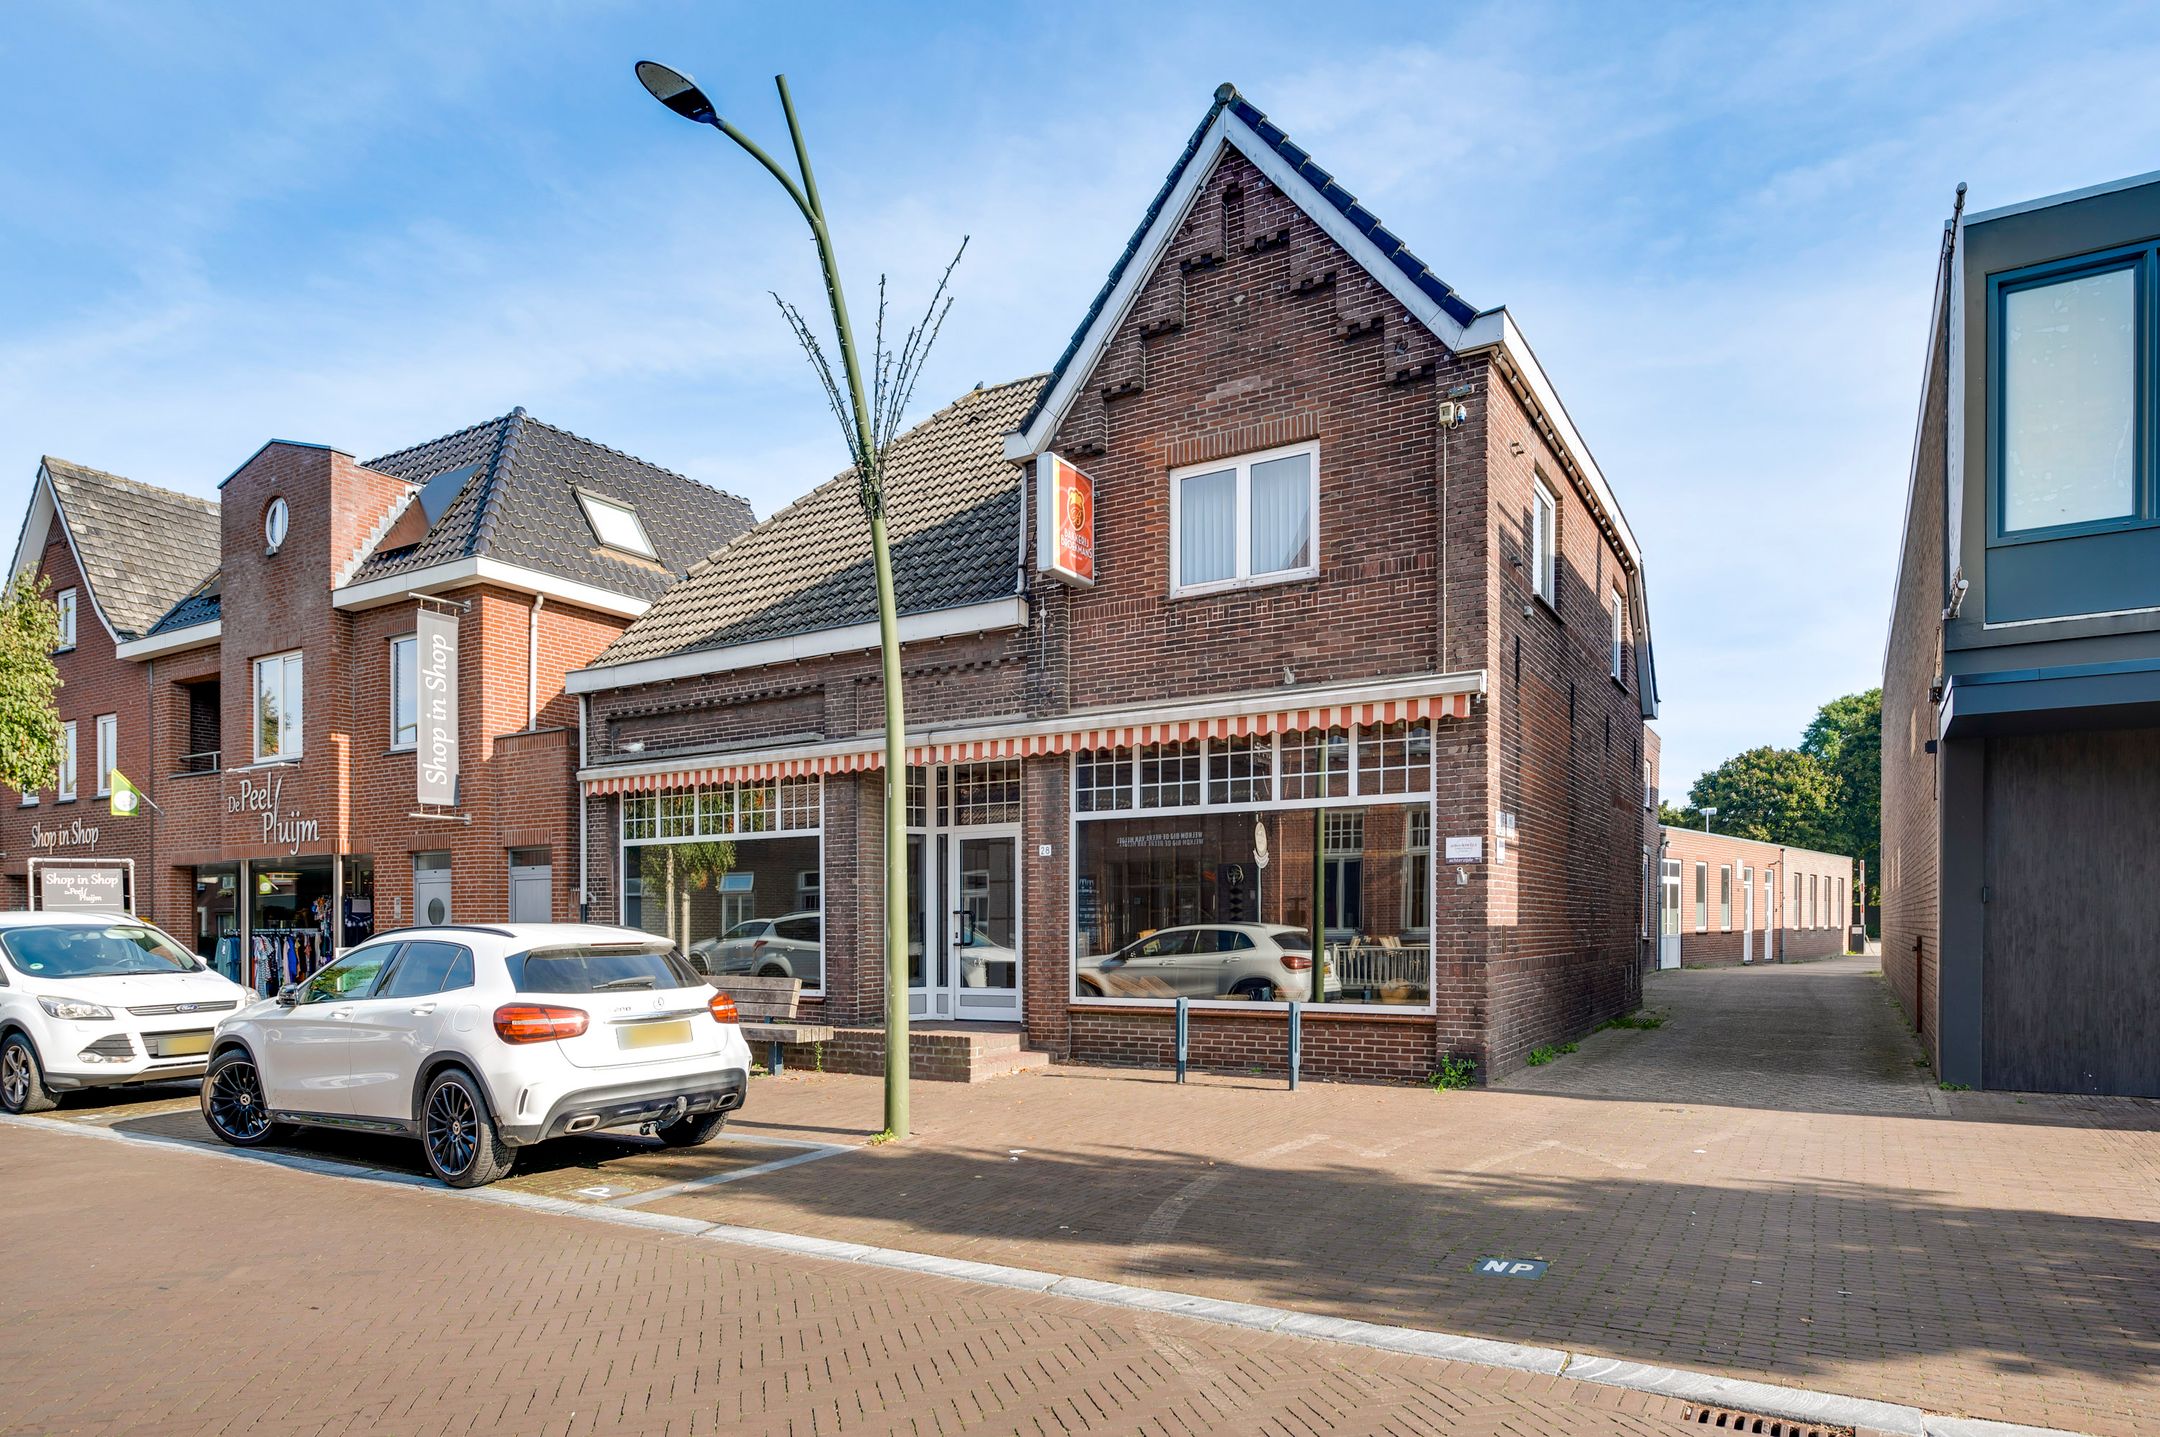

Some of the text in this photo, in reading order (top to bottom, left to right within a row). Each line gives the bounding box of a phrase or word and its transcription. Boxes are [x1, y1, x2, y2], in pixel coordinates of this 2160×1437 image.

[1060, 534, 1092, 559] BROEKMANS
[1064, 528, 1089, 547] BAKKERIJ
[422, 634, 455, 785] Shop in Shop
[228, 771, 273, 813] De Peel
[262, 775, 320, 855] Pluijm
[32, 817, 99, 855] Shop in Shop
[1041, 846, 1050, 855] 28
[46, 871, 119, 888] Shop in Shop
[70, 886, 83, 898] Peel
[1482, 1260, 1535, 1274] NP
